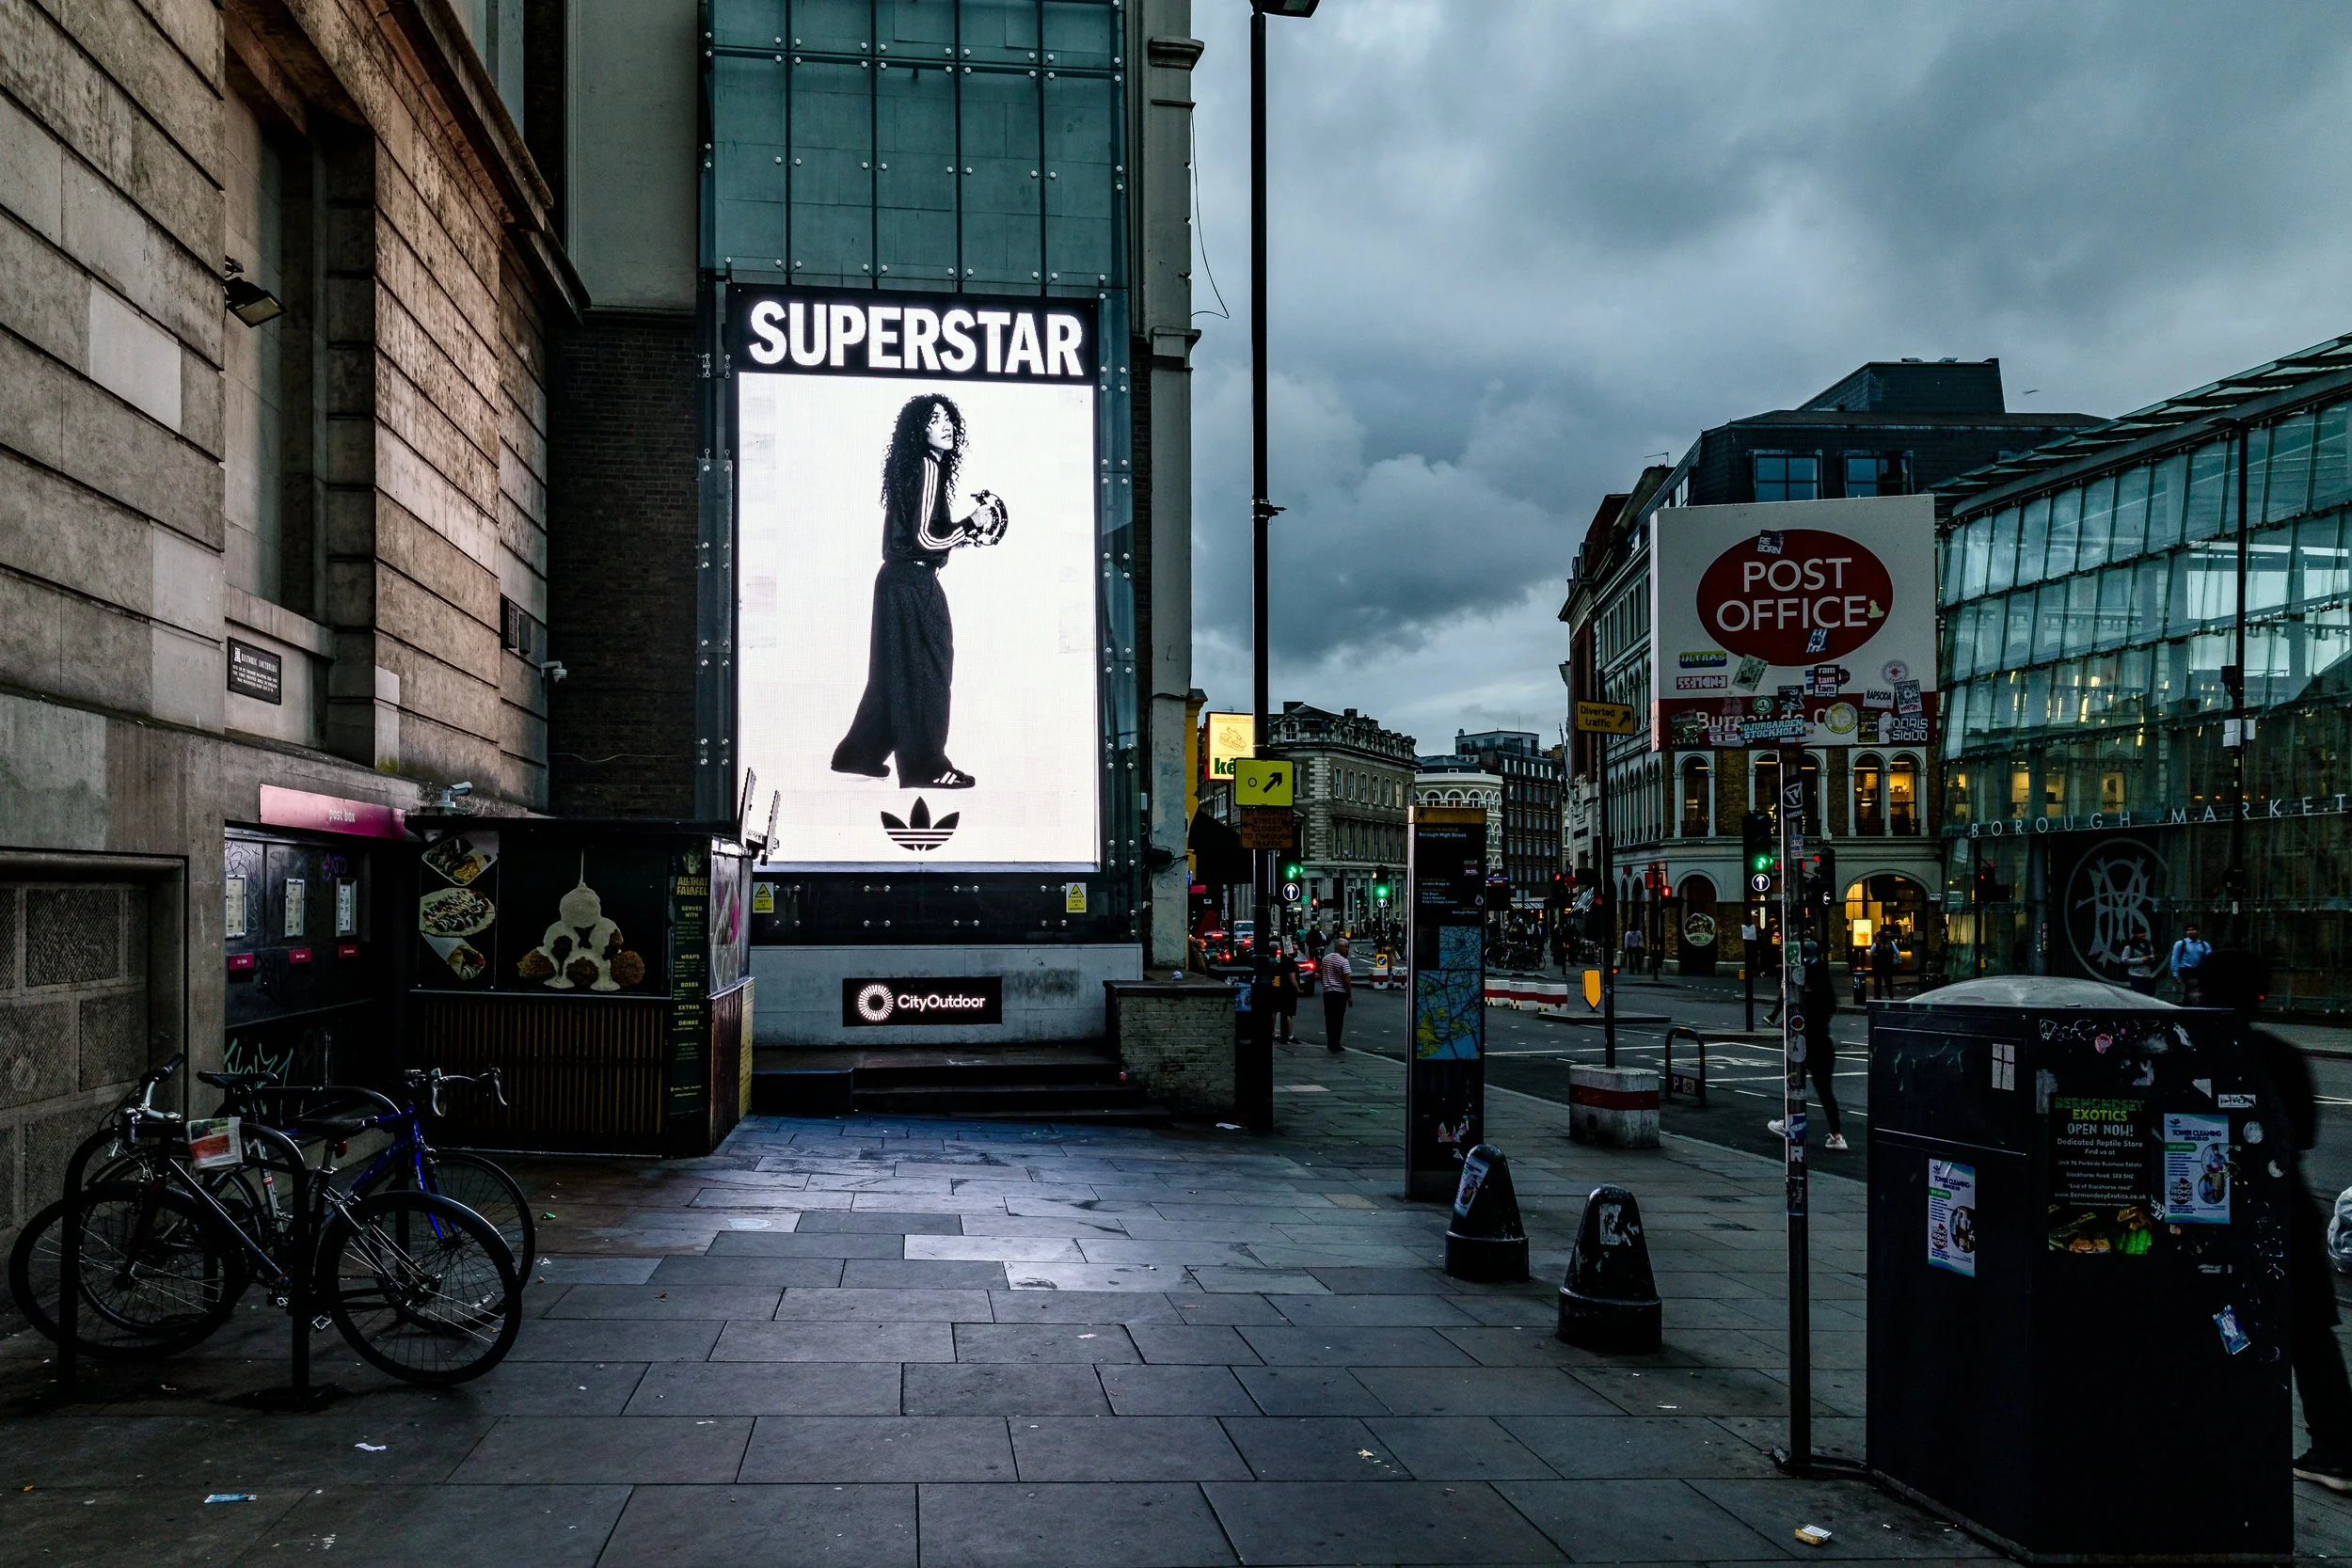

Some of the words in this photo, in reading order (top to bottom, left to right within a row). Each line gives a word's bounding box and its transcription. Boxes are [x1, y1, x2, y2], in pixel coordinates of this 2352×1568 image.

[749, 300, 1085, 376] SUPERSTAR
[1756, 545, 1782, 555] BORN
[1742, 557, 1852, 594] POST
[1715, 594, 1867, 632] OFFICE
[1818, 676, 1836, 685] tam
[1581, 705, 1615, 717] Diverted
[1585, 718, 1612, 728] traffic
[1893, 718, 1929, 729] DORIS
[1743, 727, 1804, 739] STOCKHOLM
[329, 809, 343, 822] post
[344, 810, 356, 823] box
[1971, 811, 2131, 838] BOROUGH
[2171, 793, 2346, 825] MARKET
[676, 886, 709, 896] FALAFEL
[897, 993, 987, 1013] CityOutdoor
[2055, 1096, 2145, 1112] BERMONDSEY
[2073, 1109, 2128, 1122] EXOTICS
[2067, 1122, 2098, 1135] OPEN
[2103, 1123, 2134, 1137] NOW!
[2057, 1137, 2094, 1147] Dedicated
[2096, 1138, 2122, 1148] Reptile
[2123, 1139, 2143, 1148] Store
